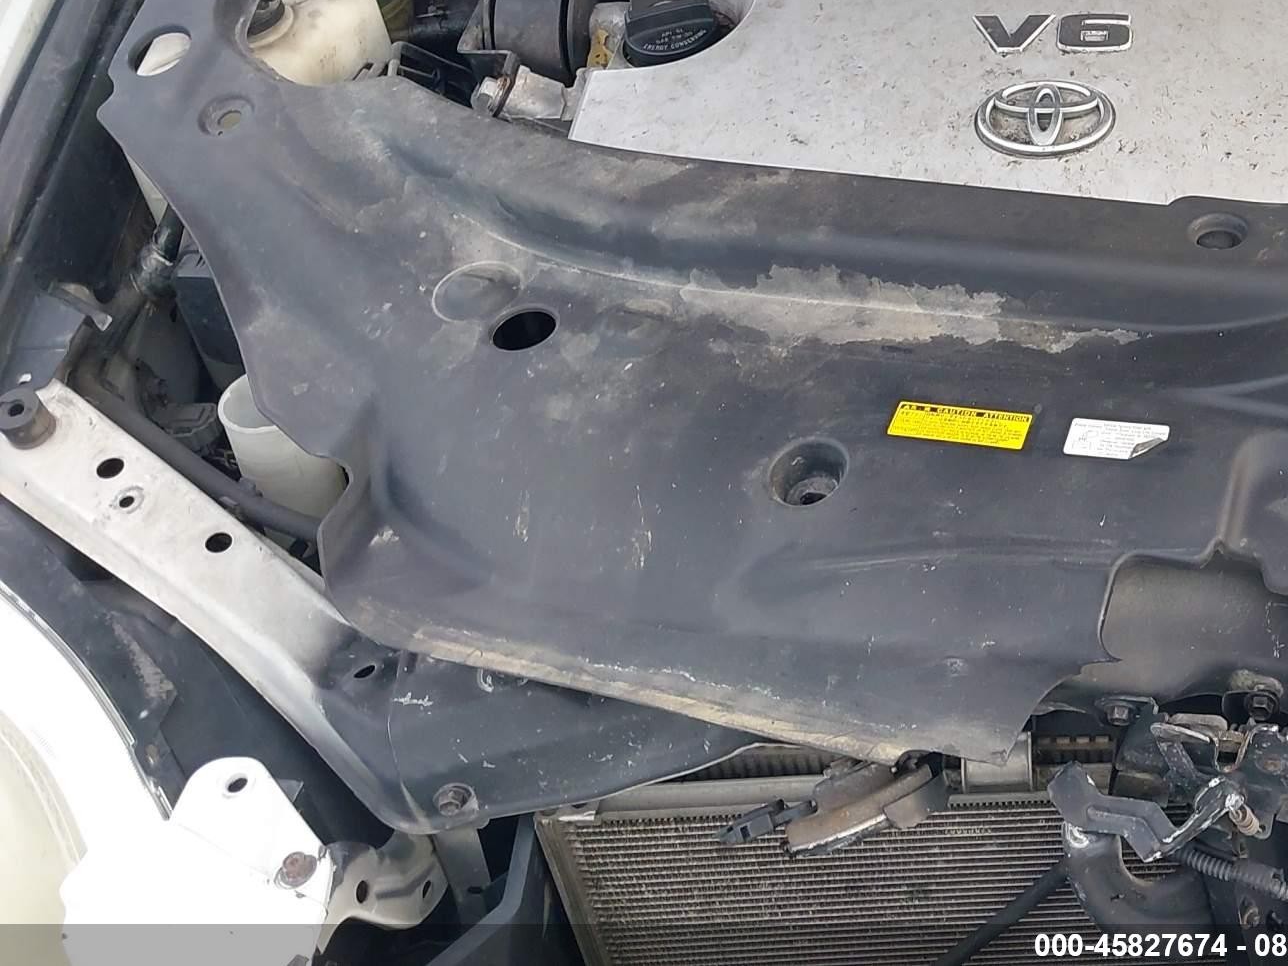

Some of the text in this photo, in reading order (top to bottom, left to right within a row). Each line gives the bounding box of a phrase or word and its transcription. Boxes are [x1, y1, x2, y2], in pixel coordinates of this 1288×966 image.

[972, 13, 1133, 53] V6
[936, 407, 977, 418] CAUTION
[983, 410, 1028, 423] ATTENTION
